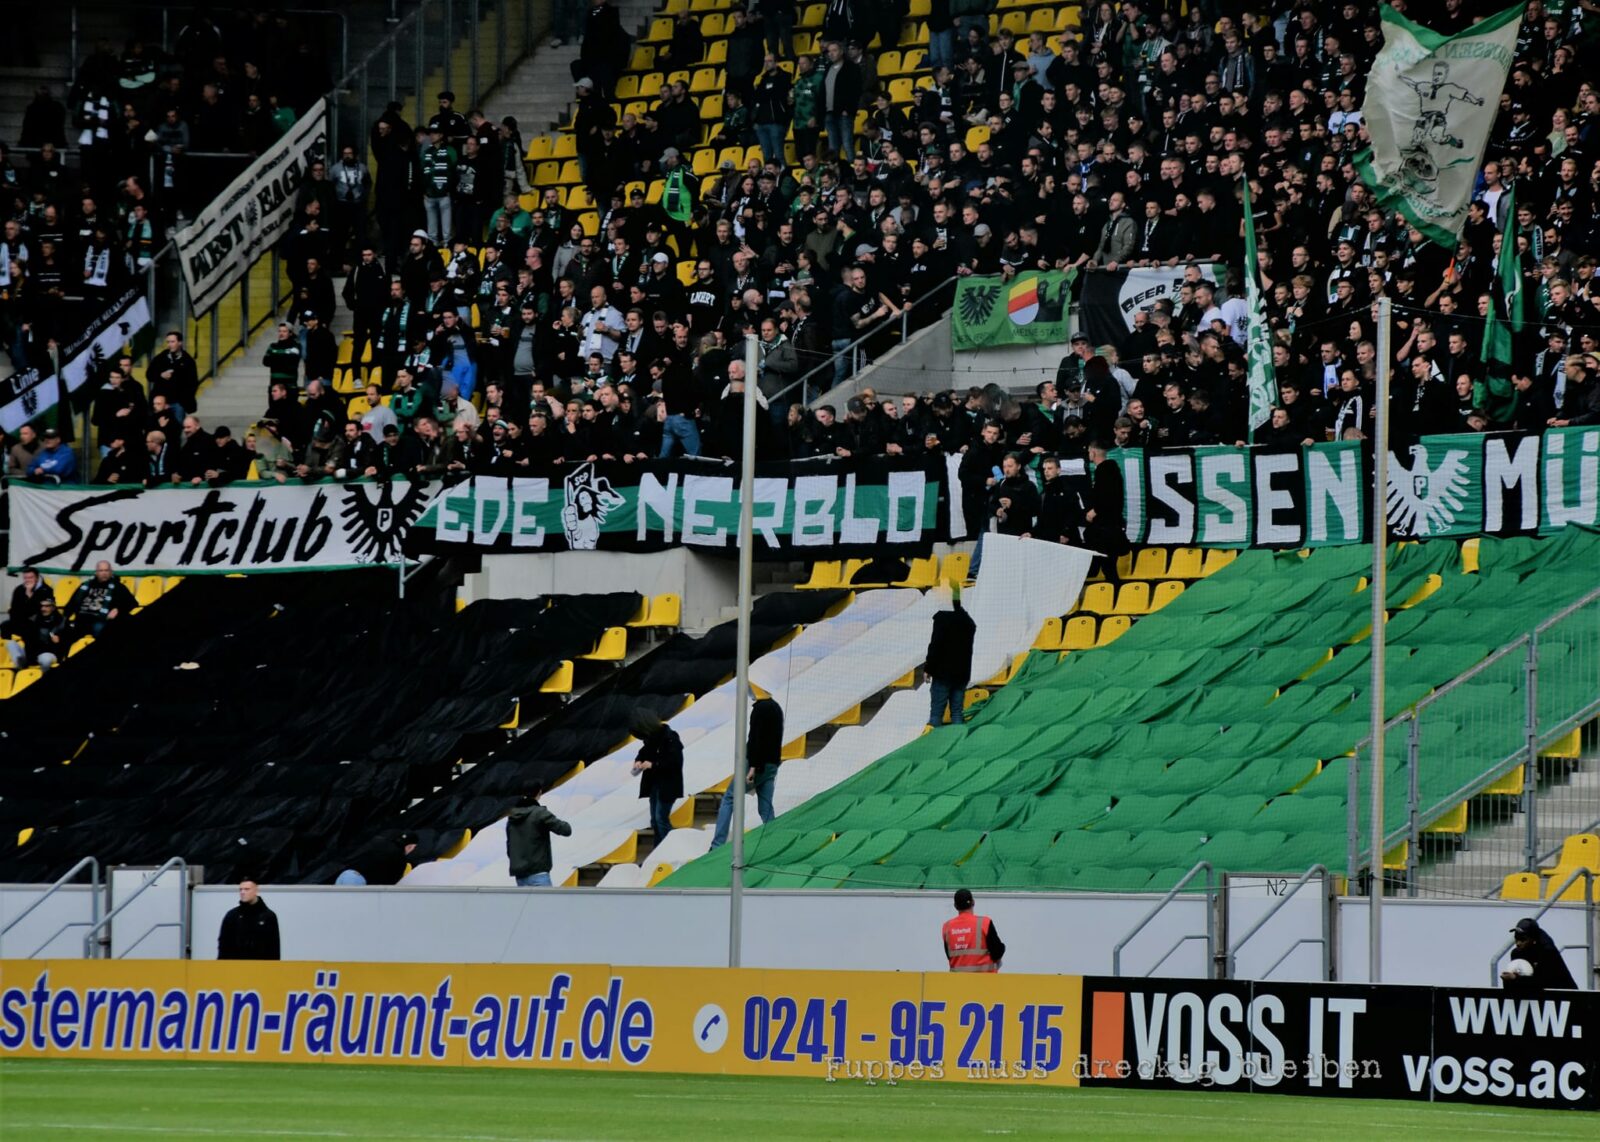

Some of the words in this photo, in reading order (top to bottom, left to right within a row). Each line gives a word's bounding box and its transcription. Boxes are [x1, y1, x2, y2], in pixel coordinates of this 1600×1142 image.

[1121, 283, 1166, 314] BEER
[8, 366, 40, 394] Linie
[574, 471, 588, 485] SCP
[23, 487, 334, 571] Sportclub
[379, 510, 389, 527] P
[436, 475, 550, 548] EDE
[1266, 879, 1287, 896] N2
[0, 972, 653, 1064] stermann-räumt-auf.de
[743, 996, 848, 1063] 0241
[889, 1000, 946, 1068] 95
[957, 1002, 1004, 1070] 21
[1019, 1004, 1064, 1072] 15
[1130, 991, 1285, 1086] VOSS
[1309, 997, 1367, 1088] IT
[1402, 1055, 1586, 1101] voss.ac
